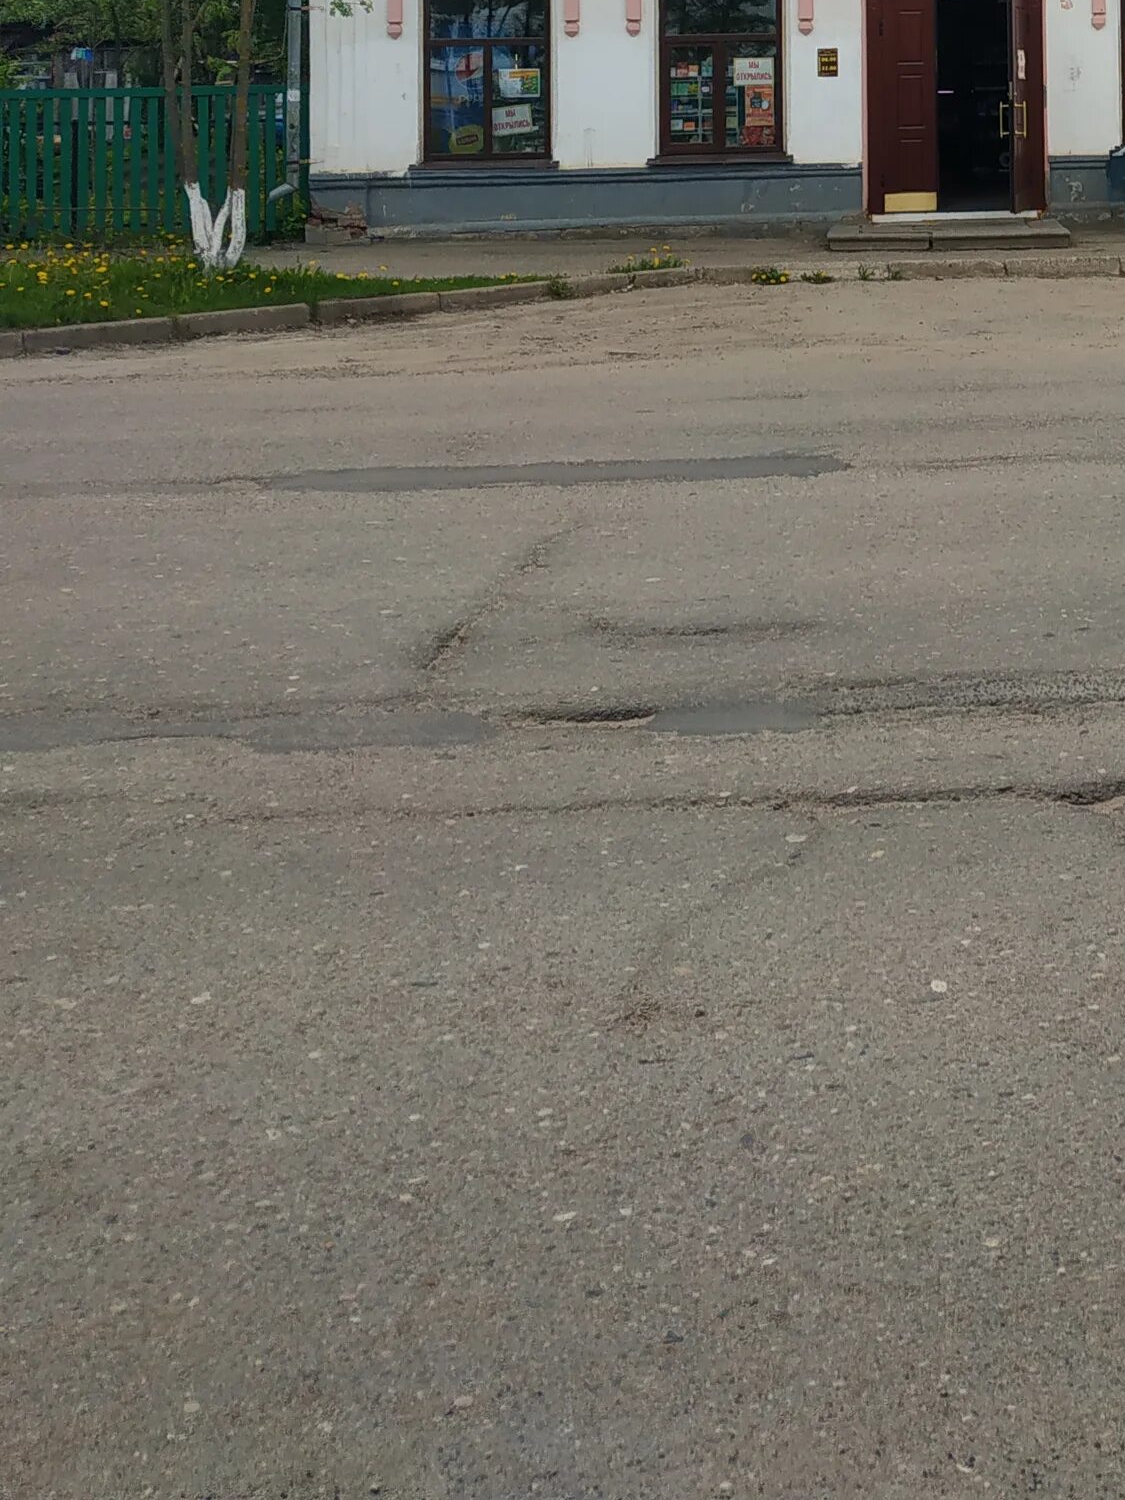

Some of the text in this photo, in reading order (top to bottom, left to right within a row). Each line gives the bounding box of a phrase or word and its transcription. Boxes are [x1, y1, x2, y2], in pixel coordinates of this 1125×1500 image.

[748, 61, 760, 69] МЫ
[736, 71, 773, 81] ОТКРЫЛИСЬ
[504, 109, 516, 118] МЫ
[493, 119, 531, 131] ОТКРЫЛИСЬ
